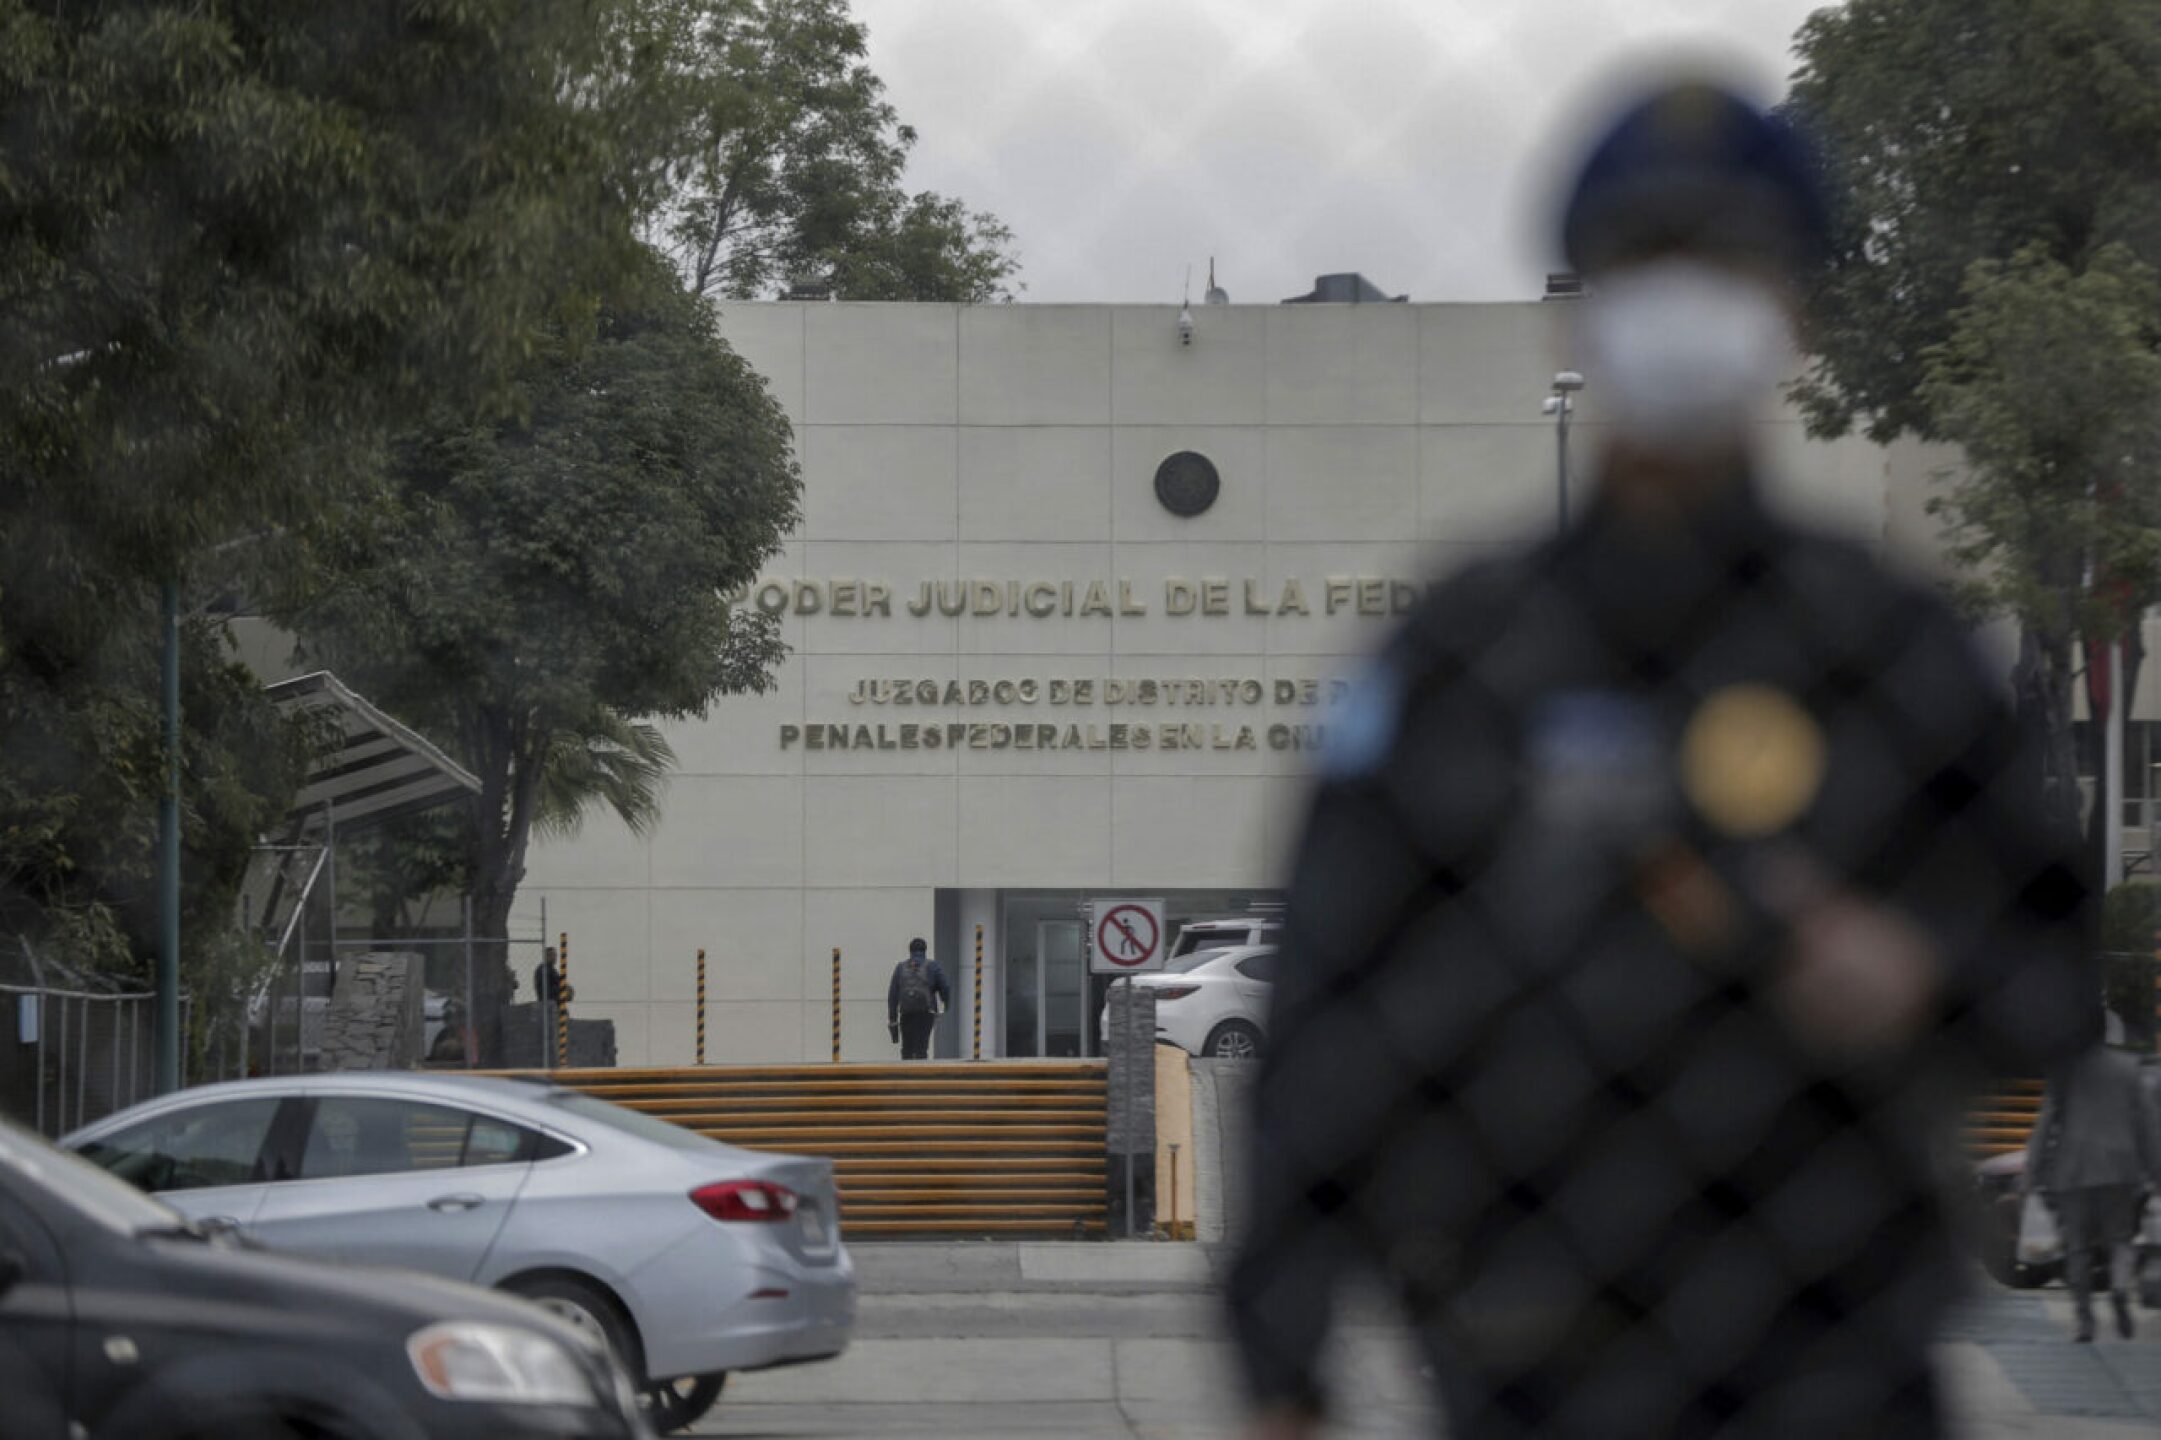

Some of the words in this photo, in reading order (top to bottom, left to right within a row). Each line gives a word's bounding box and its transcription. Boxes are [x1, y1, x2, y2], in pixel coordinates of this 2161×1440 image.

[907, 578, 1147, 617] JUDICIAL
[1165, 577, 1230, 616] DE
[1243, 576, 1311, 616] LA
[848, 679, 1040, 705] JUZGADOS
[1048, 679, 1095, 705] DE
[1103, 679, 1264, 705] DISTRITO
[1273, 679, 1320, 705] DE
[780, 723, 942, 750] PENALES
[946, 723, 1152, 750] FEDERALES
[1158, 723, 1203, 750] EN
[1211, 723, 1257, 750] LA
